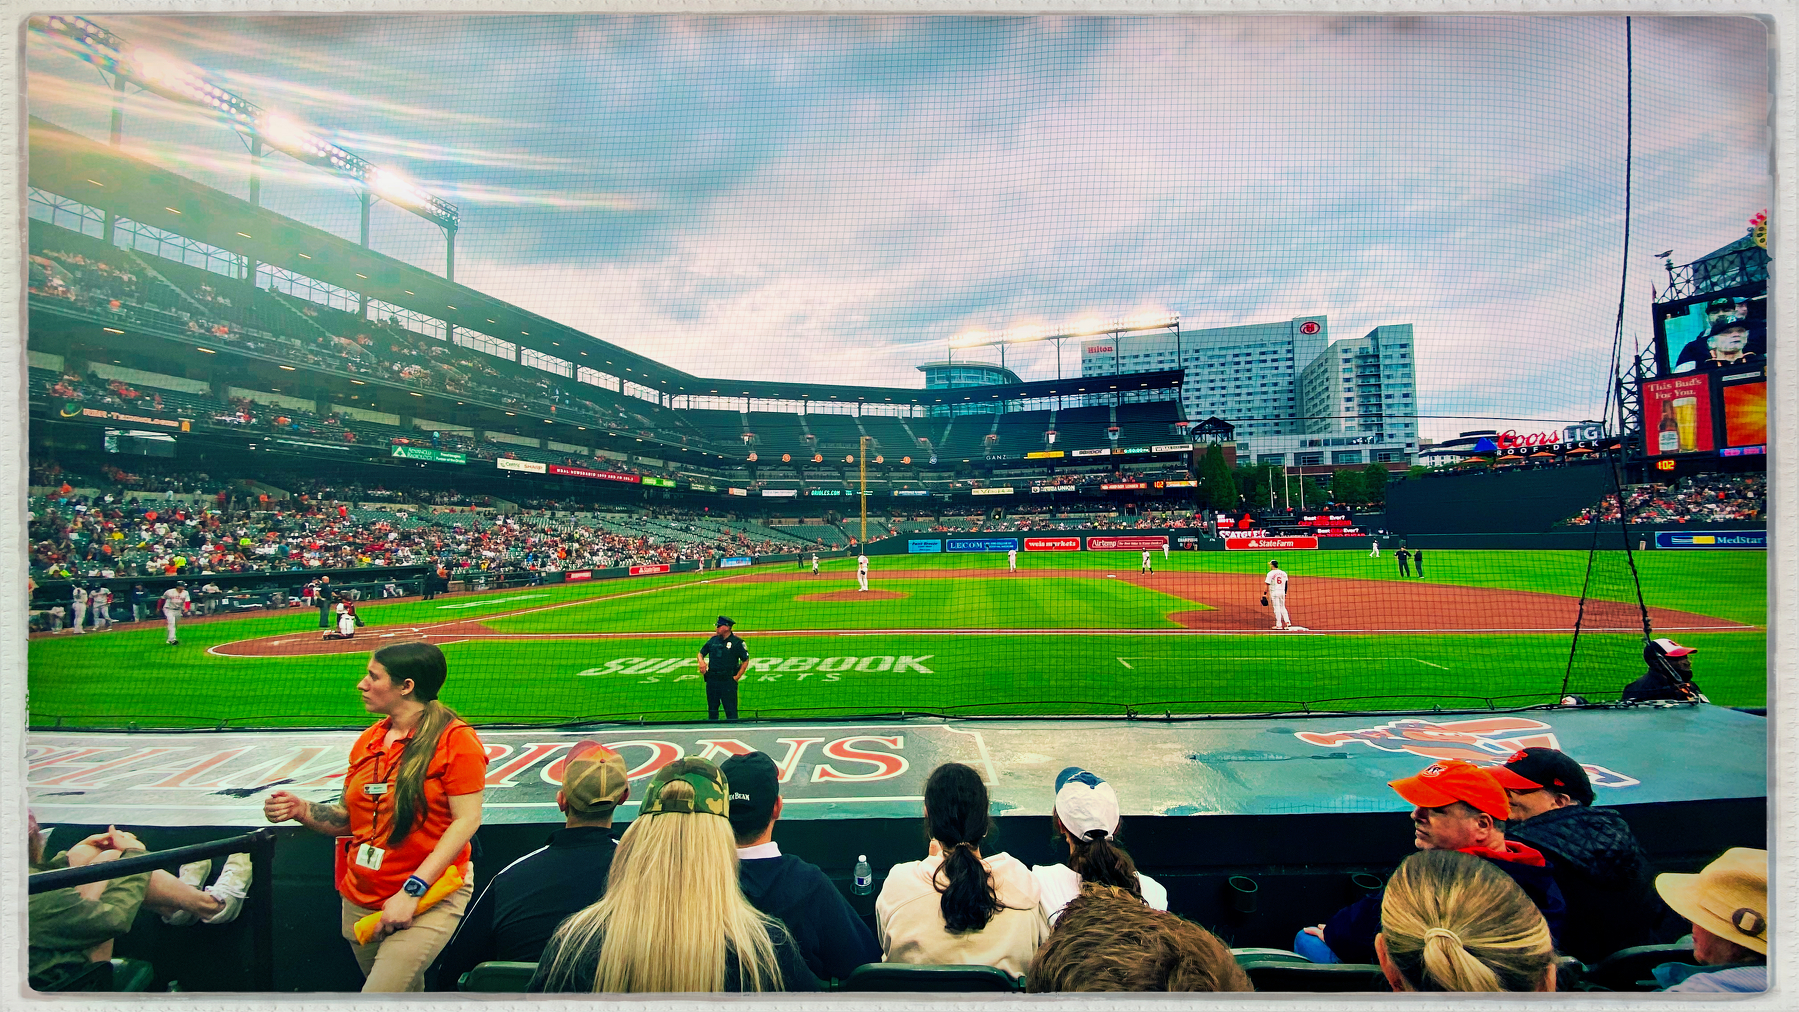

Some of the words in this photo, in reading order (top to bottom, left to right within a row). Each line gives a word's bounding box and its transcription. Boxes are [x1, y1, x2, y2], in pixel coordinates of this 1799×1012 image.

[1088, 346, 1114, 354] Hilton
[1648, 382, 1672, 391] This
[1675, 377, 1702, 388] Bud's
[1497, 429, 1559, 449] Coors
[1496, 446, 1539, 456] ROOF
[1553, 440, 1599, 451] DECK
[1091, 539, 1117, 548] Airtemp
[1717, 536, 1763, 544] MedStar
[1276, 576, 1282, 585] 6
[576, 654, 934, 677] SUPRBOOK
[638, 672, 842, 684] SPRTS
